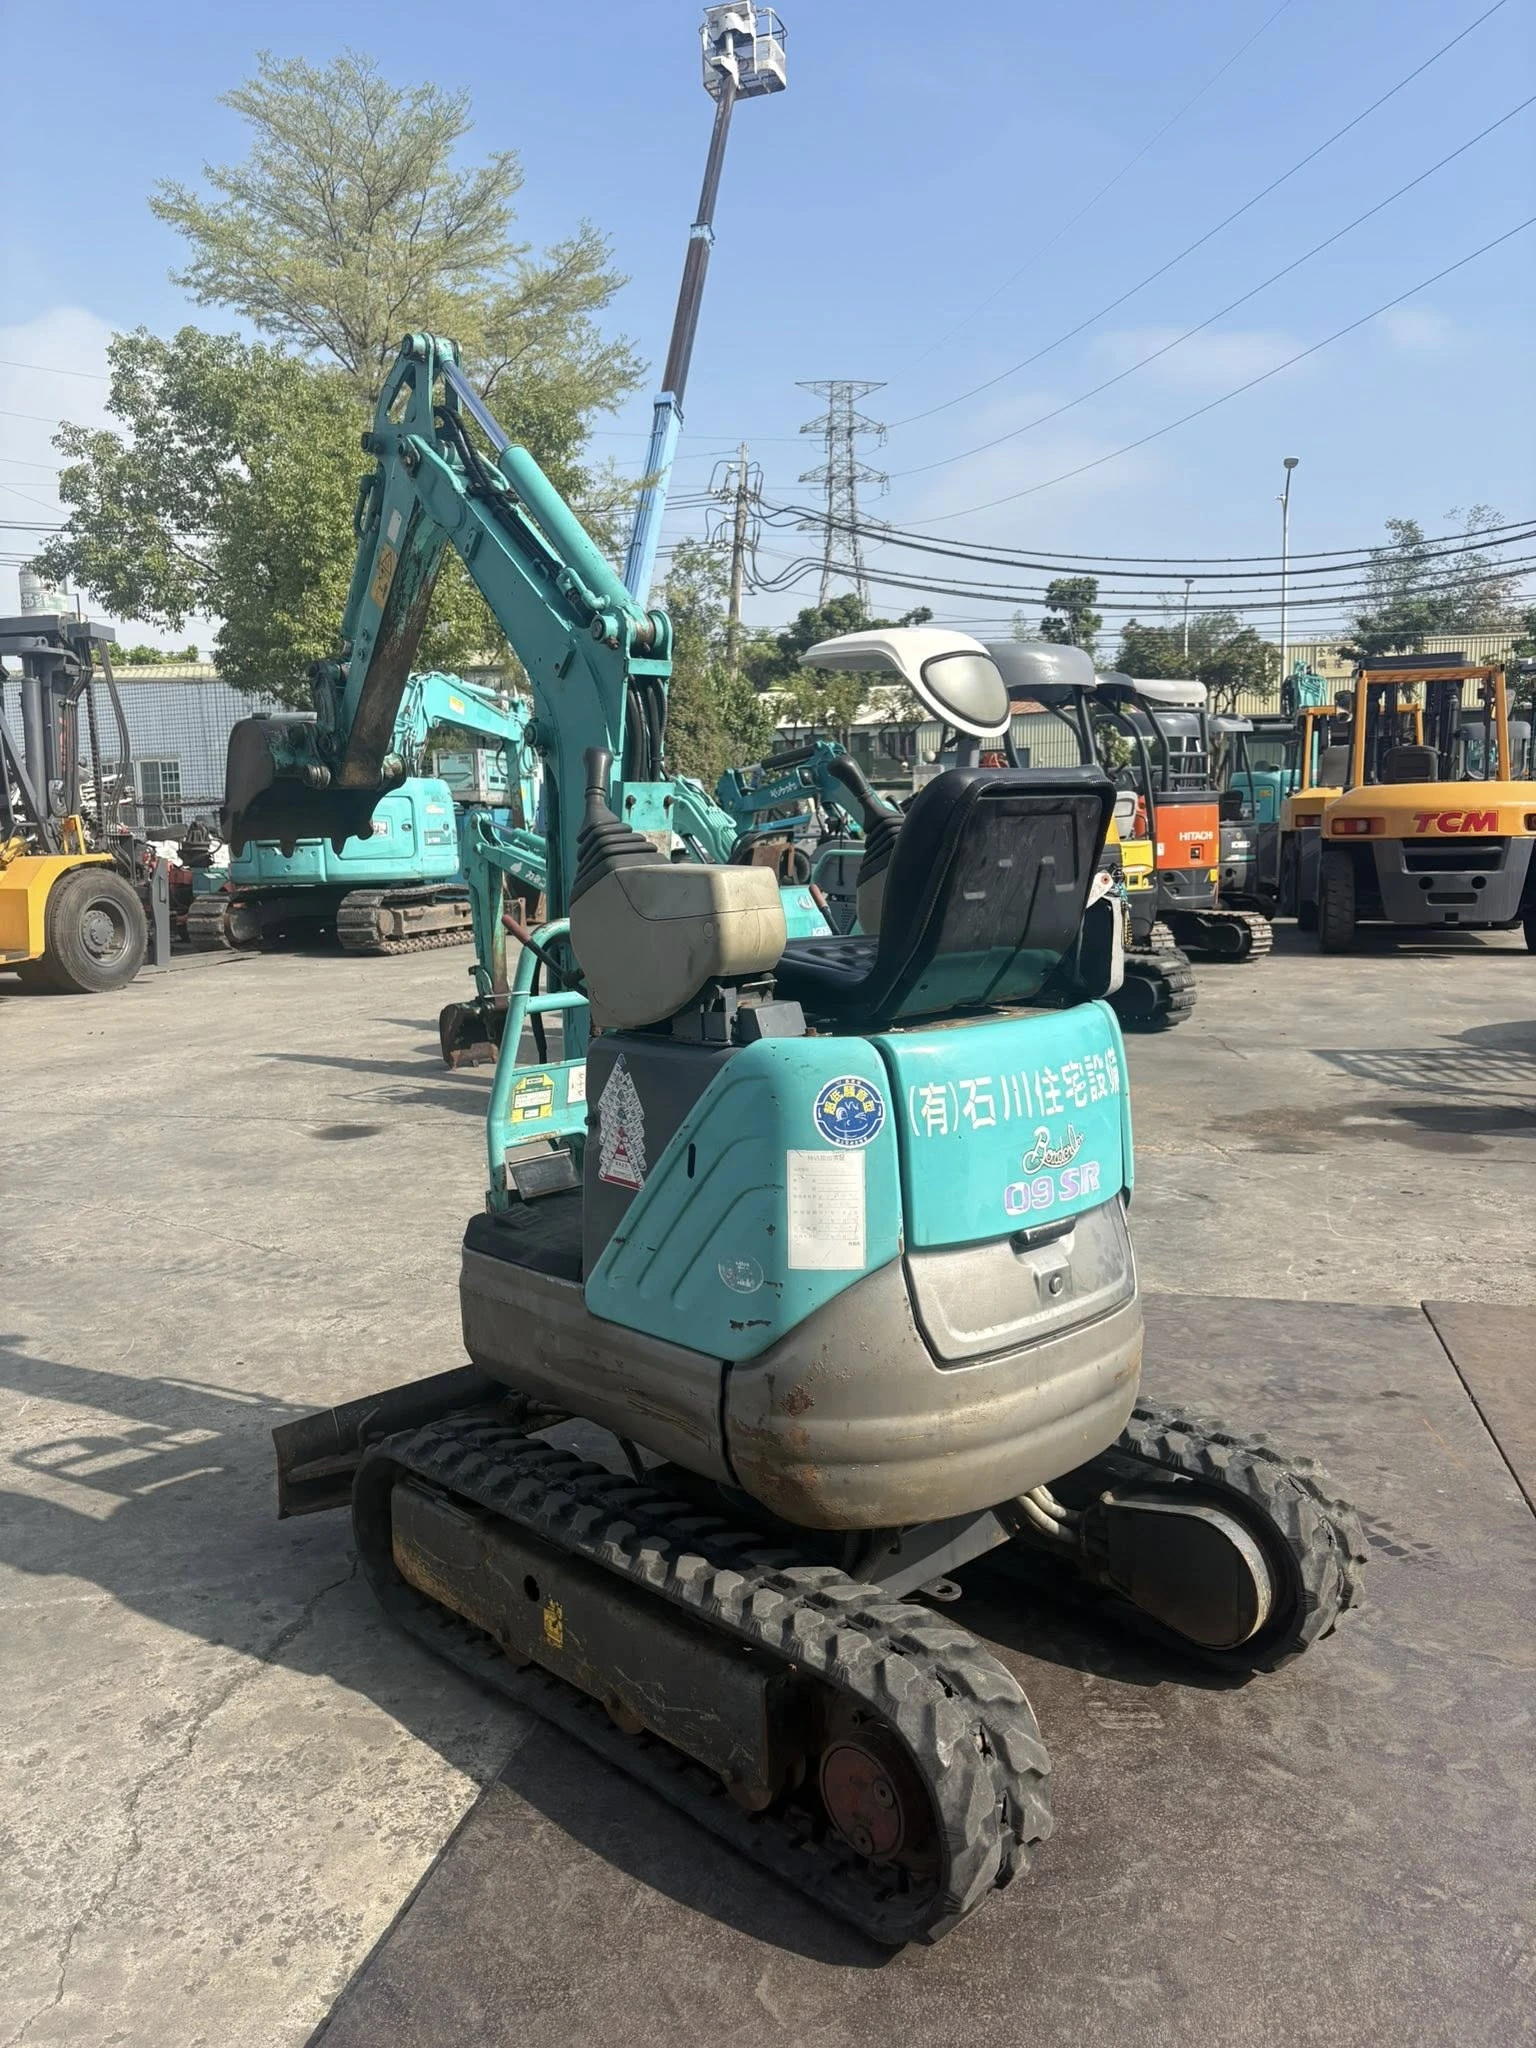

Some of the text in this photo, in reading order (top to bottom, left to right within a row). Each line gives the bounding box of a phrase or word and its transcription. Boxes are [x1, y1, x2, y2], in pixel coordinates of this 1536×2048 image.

[1412, 810, 1499, 834] TCM
[1179, 831, 1213, 841] HITACHI
[1004, 1161, 1101, 1216] 09 SR
